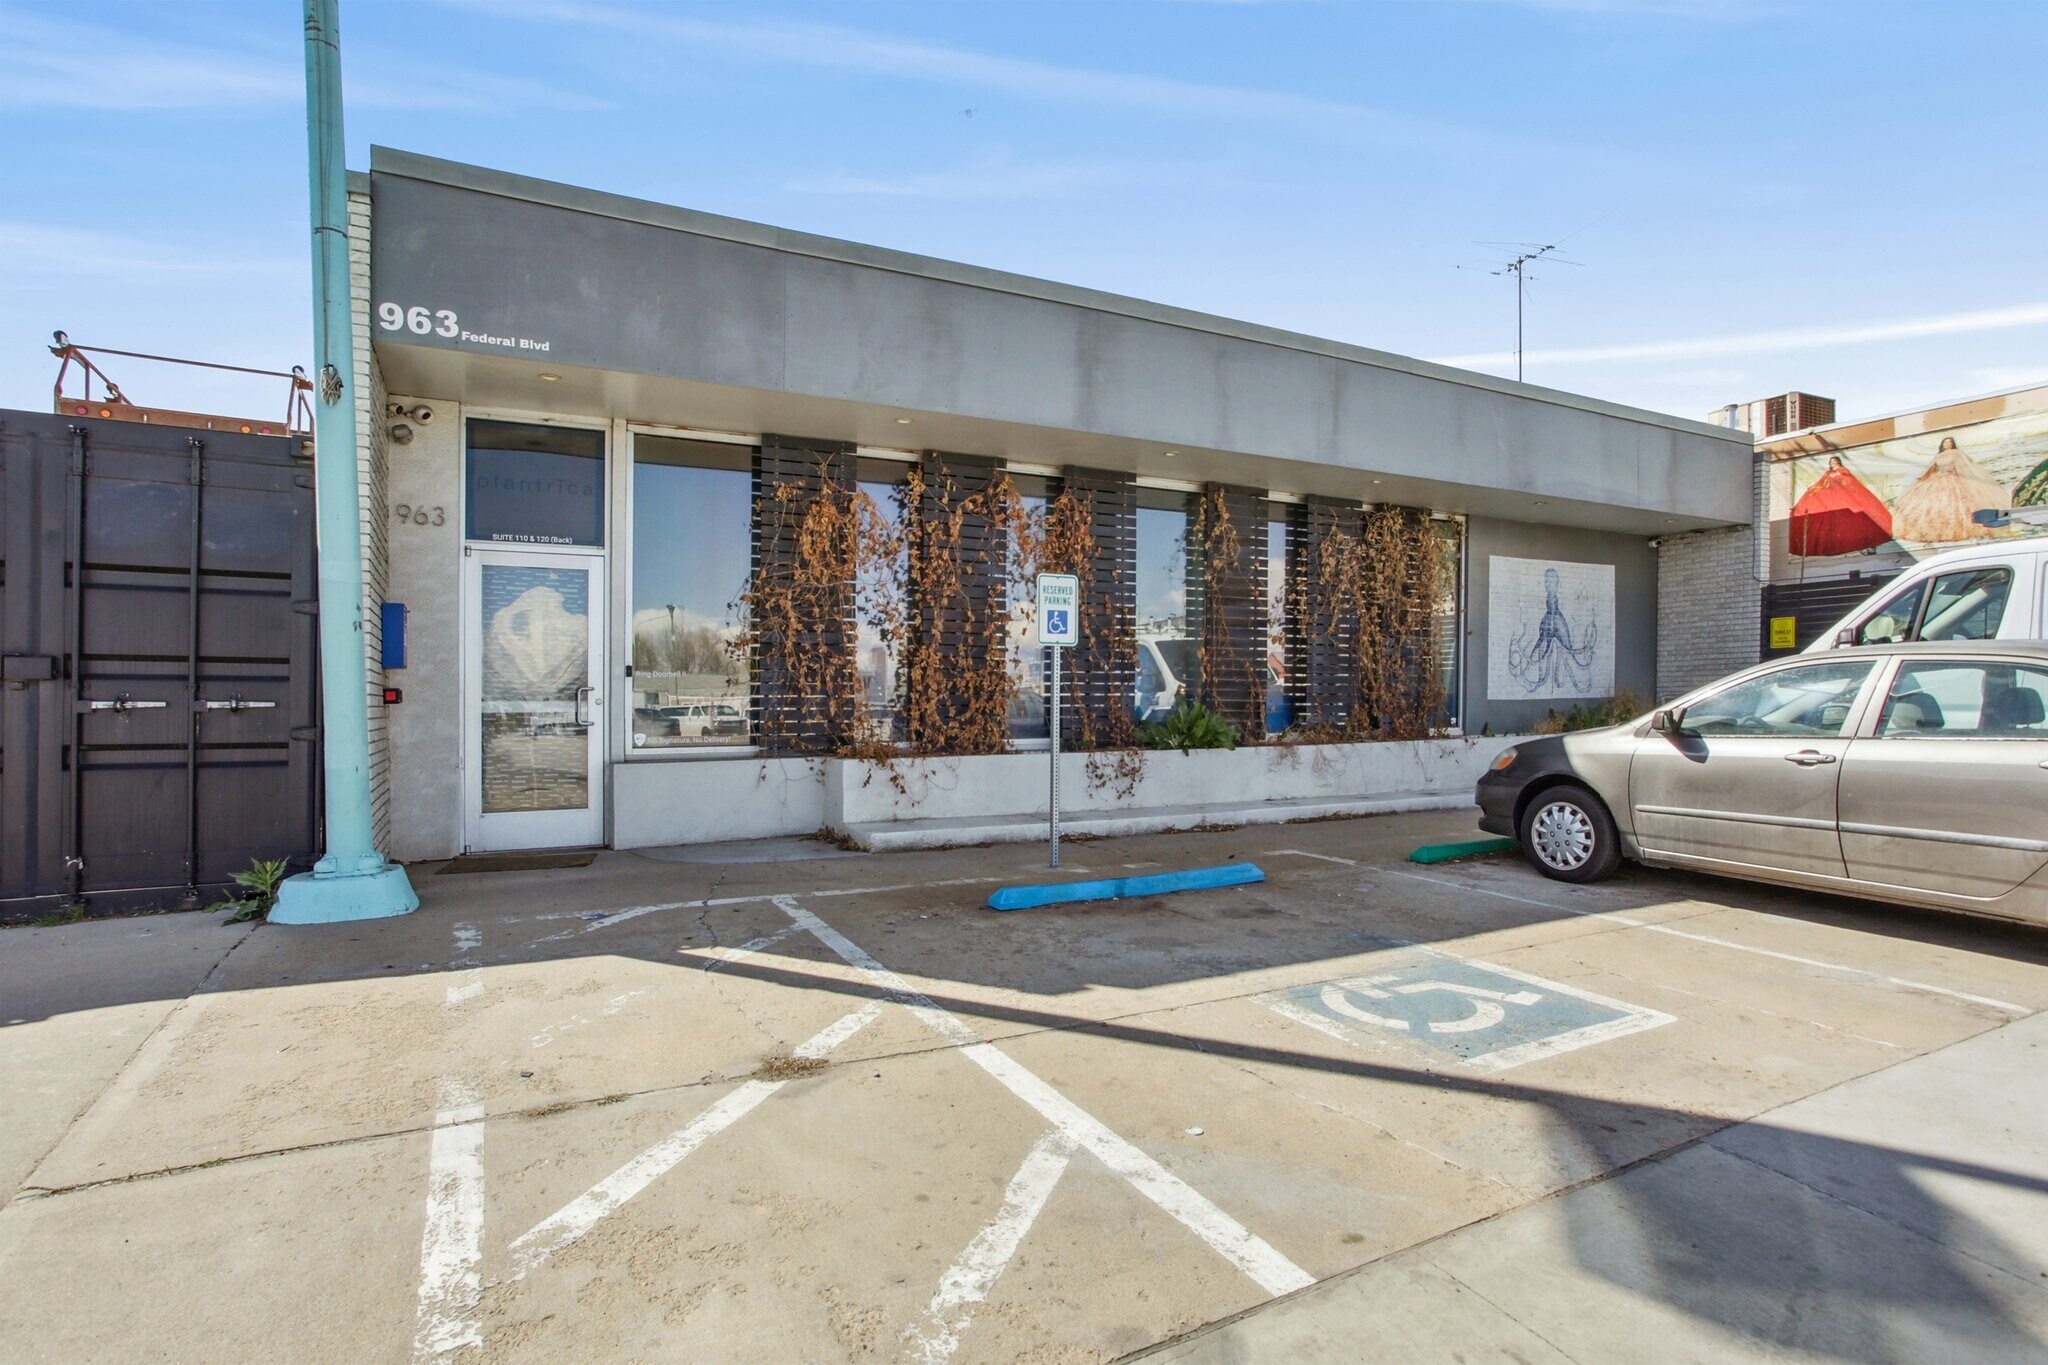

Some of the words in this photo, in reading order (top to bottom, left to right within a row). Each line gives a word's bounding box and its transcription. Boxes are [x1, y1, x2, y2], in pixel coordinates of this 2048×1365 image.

[378, 302, 460, 338] 963
[461, 331, 516, 348] Federal
[519, 338, 550, 351] Blvd
[477, 474, 594, 496] plantrica
[396, 503, 446, 527] 963
[492, 533, 514, 541] SUITE
[515, 534, 529, 542] 110
[536, 535, 550, 543] 120
[550, 536, 573, 544] (Back)
[1042, 585, 1073, 596] RESERVED
[1044, 596, 1071, 606] PARKING
[635, 670, 651, 679] Ring
[652, 670, 681, 678] Doorbell
